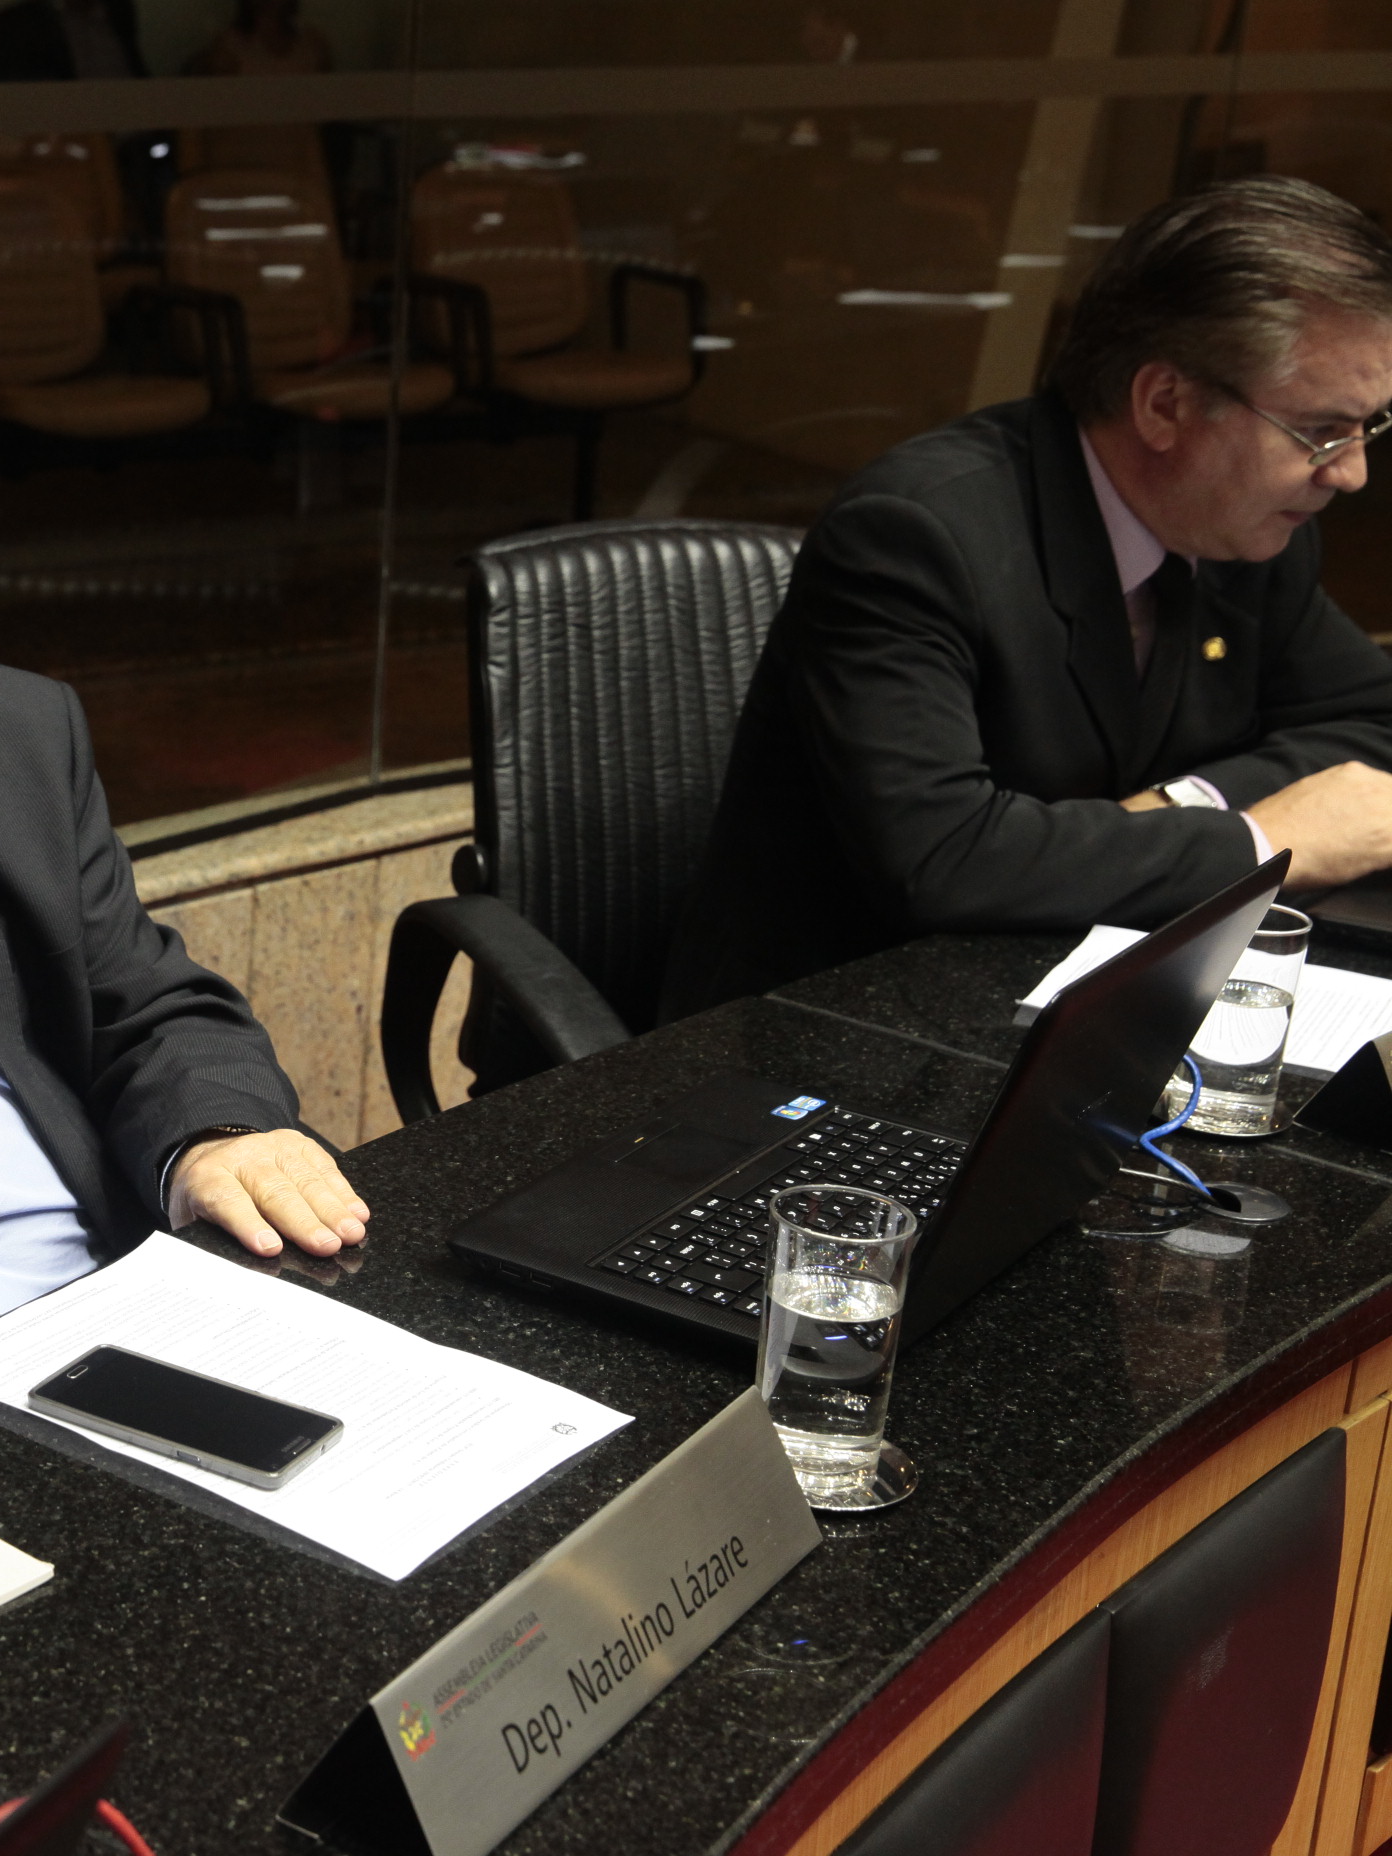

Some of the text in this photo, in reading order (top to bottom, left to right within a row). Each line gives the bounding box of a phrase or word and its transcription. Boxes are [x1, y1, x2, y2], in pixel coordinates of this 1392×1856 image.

[500, 1703, 573, 1775] Dep.
[566, 1602, 676, 1715] Natalino
[669, 1535, 749, 1620] Lázare
